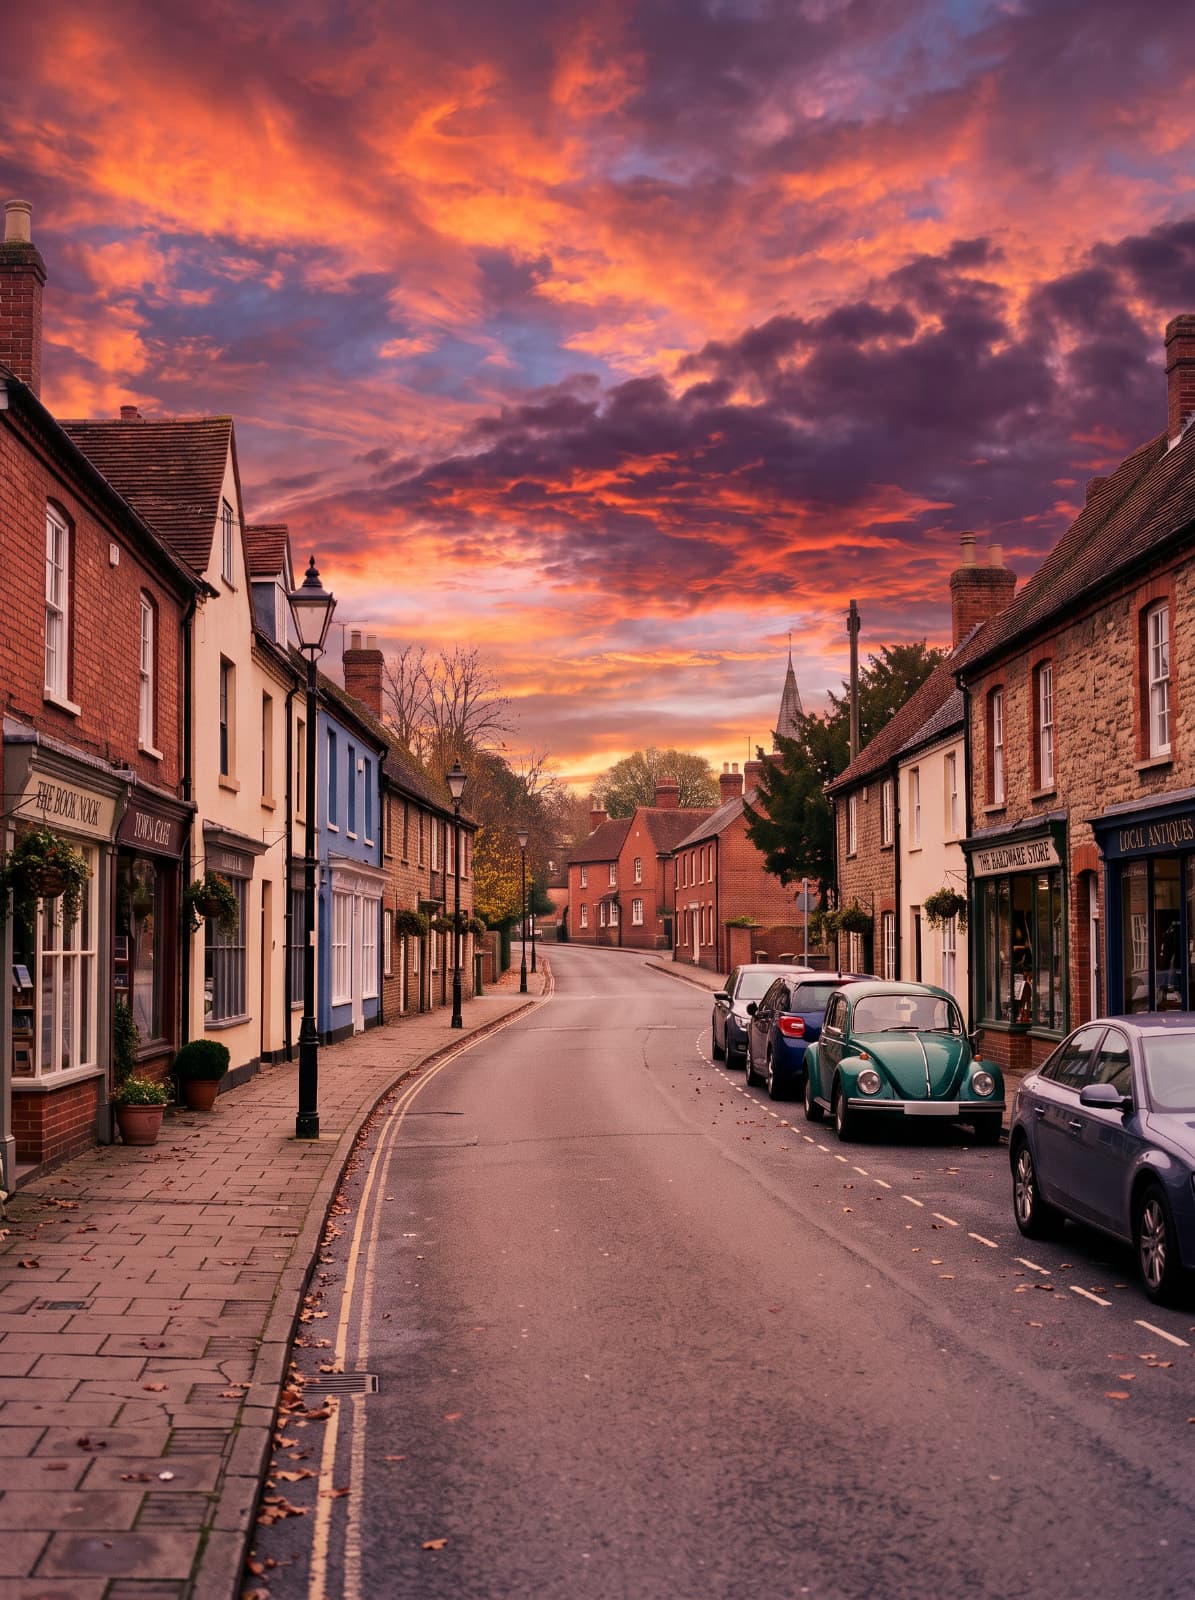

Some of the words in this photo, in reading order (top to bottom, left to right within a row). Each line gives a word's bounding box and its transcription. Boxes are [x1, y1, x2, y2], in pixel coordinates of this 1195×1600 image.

[36, 780, 55, 811] THE
[54, 786, 78, 820] BOOK
[77, 796, 101, 826] NOOK
[1119, 827, 1146, 852] LOCAL
[1148, 818, 1194, 848] ANTIQUES
[978, 853, 991, 871] THE
[990, 846, 1027, 870] HARDWARE
[1027, 841, 1051, 864] STORE
